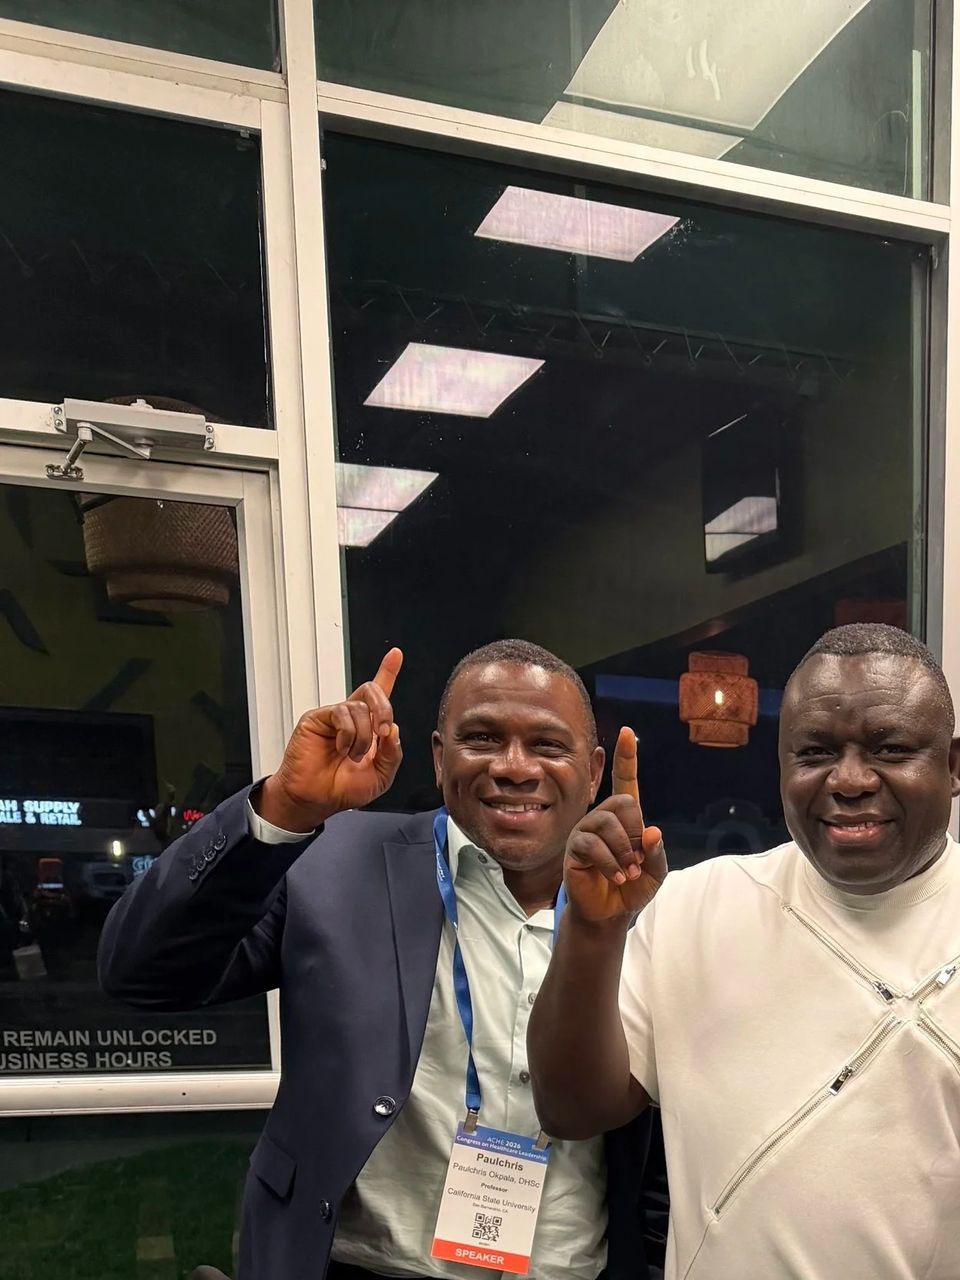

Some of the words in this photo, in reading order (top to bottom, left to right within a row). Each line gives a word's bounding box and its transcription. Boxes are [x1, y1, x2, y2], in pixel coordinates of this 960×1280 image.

[23, 800, 80, 814] SUPPLY
[25, 811, 36, 824] &
[40, 812, 82, 826] RETAIL
[3, 1030, 90, 1047] REMAIN
[96, 1029, 217, 1046] UNLOCKED
[95, 1051, 172, 1068] HOURS
[456, 1135, 481, 1148] Congress
[489, 1142, 518, 1154] Healthcare
[486, 1136, 504, 1146] ACHE
[505, 1140, 521, 1149] 2026
[476, 1153, 524, 1171] Paulchris
[453, 1162, 487, 1177] Paulchris
[488, 1170, 517, 1184] Okpala,
[518, 1177, 541, 1189] DHSc
[447, 1187, 480, 1201] California
[482, 1194, 501, 1205] State
[502, 1199, 536, 1214] University
[455, 1248, 505, 1265] SPEAKER
